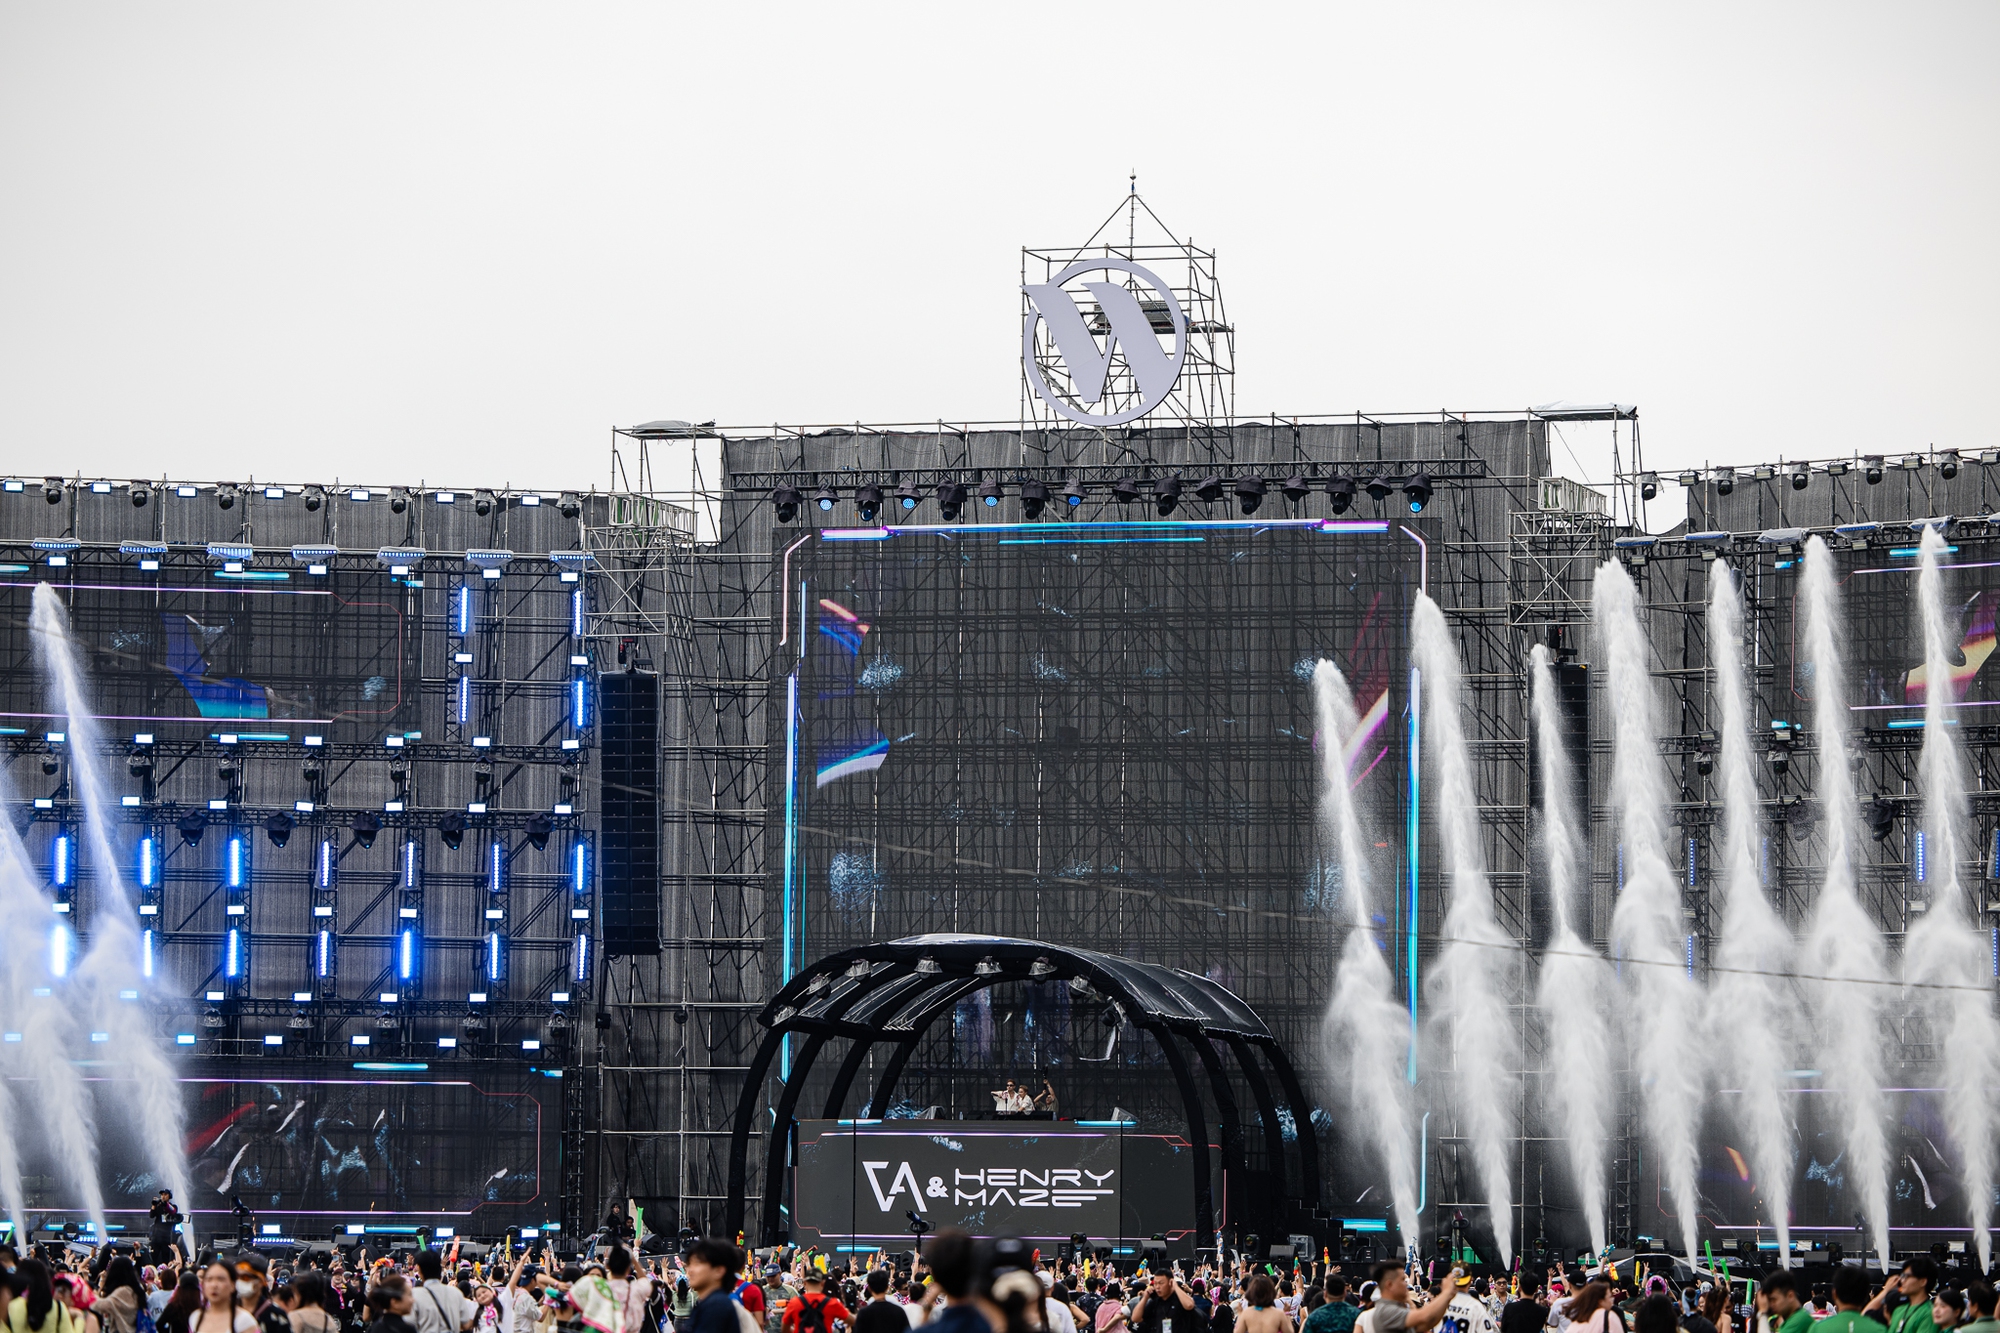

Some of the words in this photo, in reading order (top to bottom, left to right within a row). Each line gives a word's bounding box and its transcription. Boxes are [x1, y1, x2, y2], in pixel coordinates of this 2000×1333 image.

[925, 1176, 949, 1198] &
[954, 1168, 1115, 1187] HENRY
[954, 1188, 1115, 1207] MAZE
